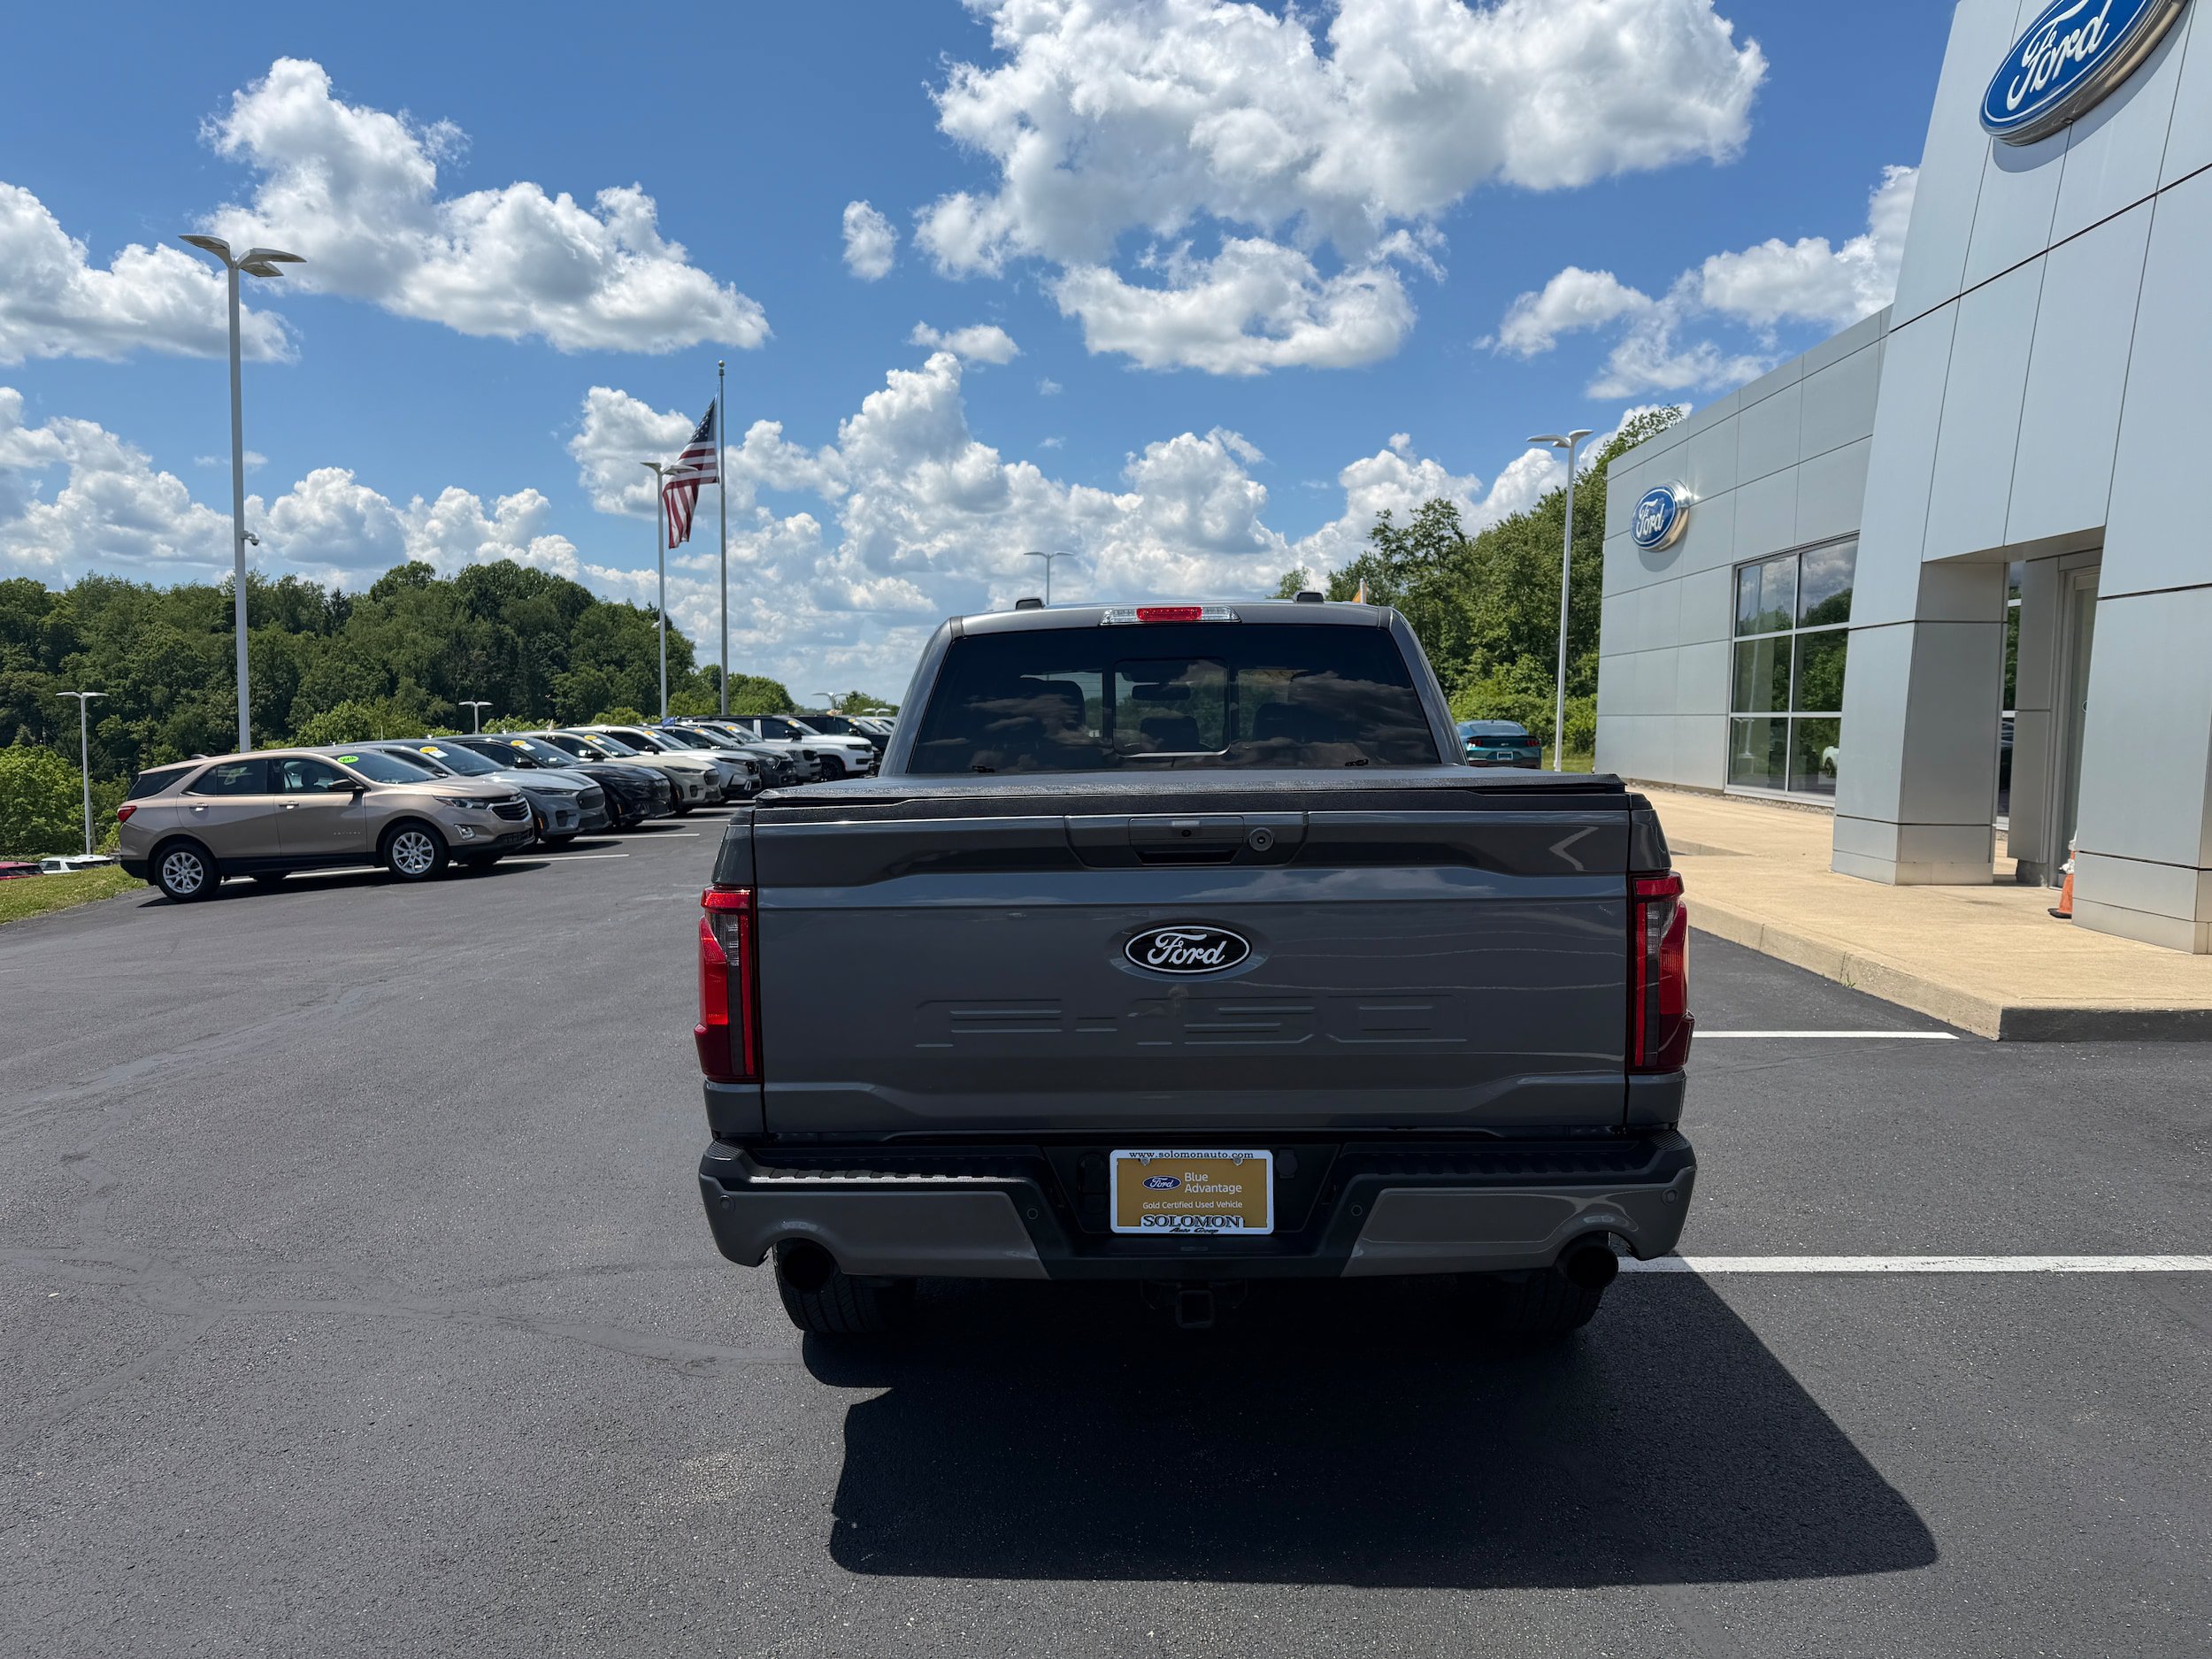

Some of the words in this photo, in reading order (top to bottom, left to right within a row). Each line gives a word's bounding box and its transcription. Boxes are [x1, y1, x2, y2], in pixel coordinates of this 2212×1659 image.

[2006, 0, 2115, 111] Ford
[1635, 498, 1665, 538] Ford
[1147, 932, 1227, 964] Ford
[915, 995, 1466, 1048] F-150
[1129, 1150, 1255, 1159] www.solomonauto.com
[1149, 1176, 1175, 1188] Ford
[1185, 1172, 1209, 1182] Blue
[1184, 1184, 1242, 1194] Advantage
[1142, 1215, 1240, 1228] SOLOMON
